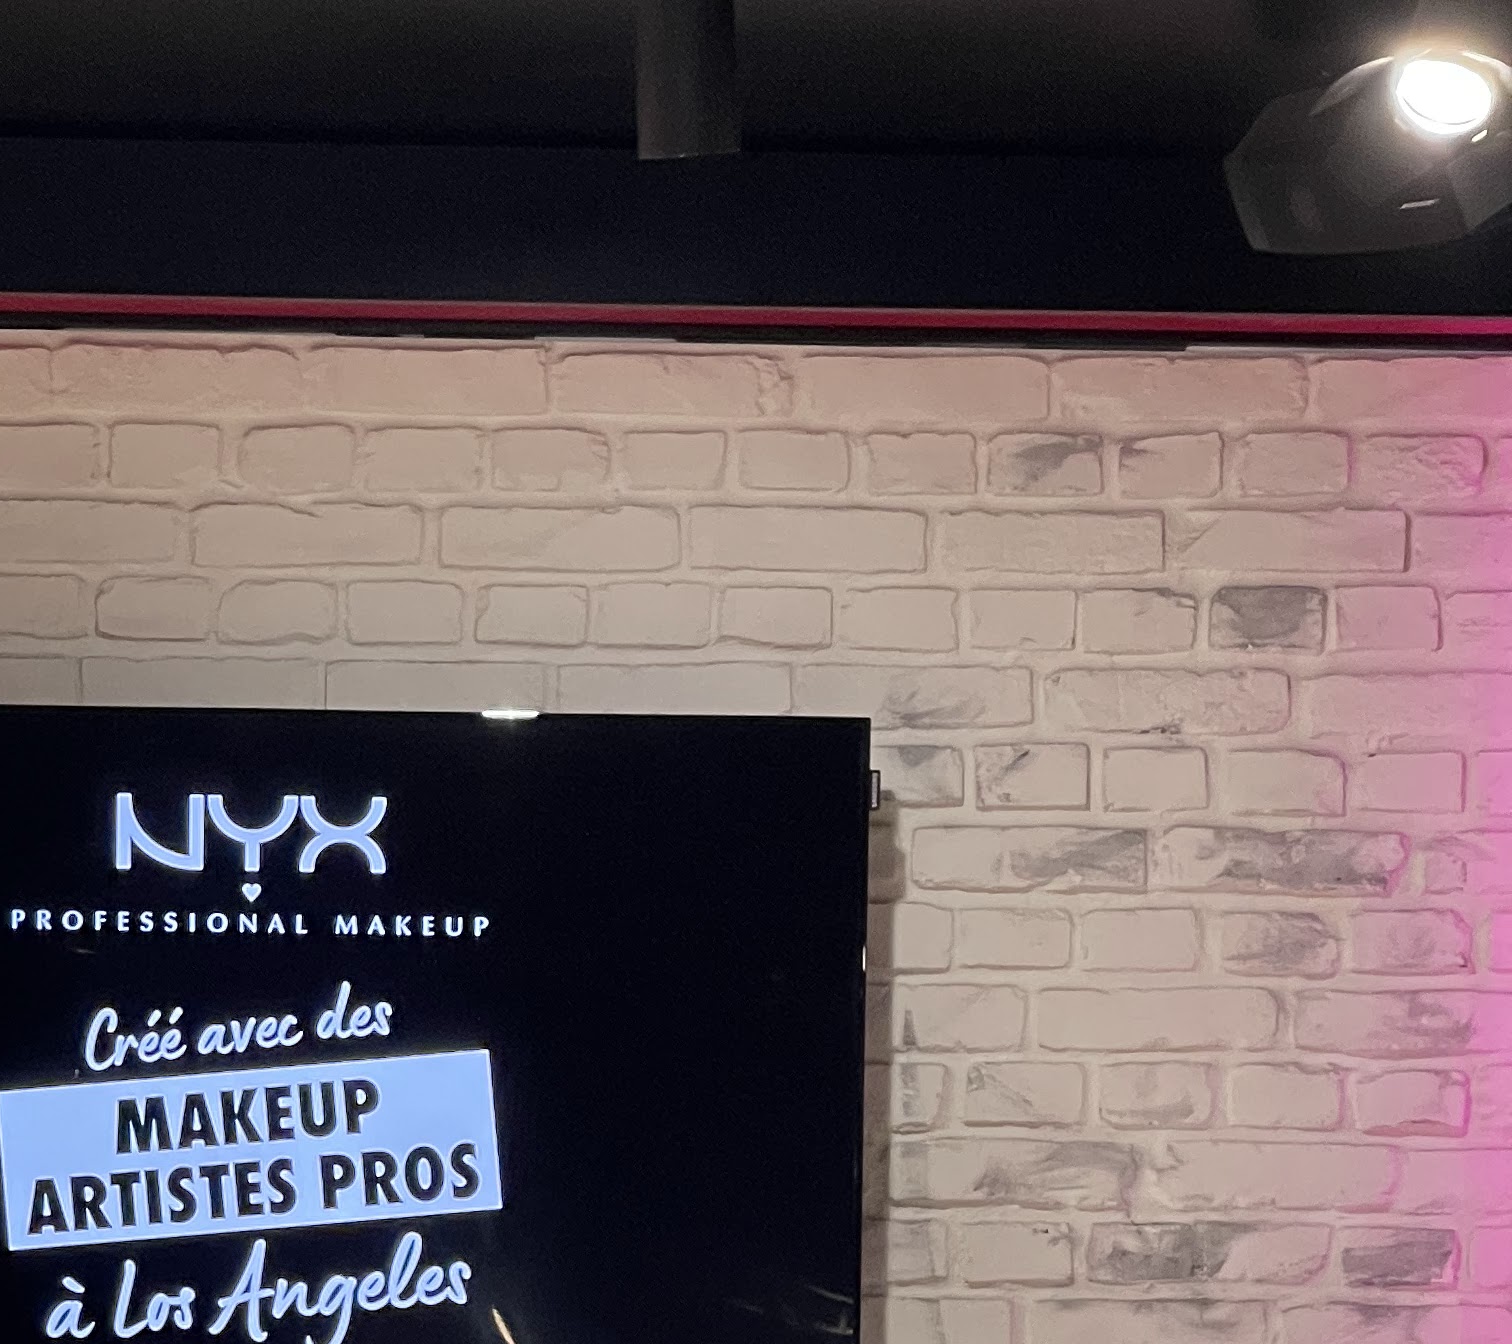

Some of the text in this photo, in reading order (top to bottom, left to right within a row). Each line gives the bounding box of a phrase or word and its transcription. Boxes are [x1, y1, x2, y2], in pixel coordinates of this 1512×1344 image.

[114, 790, 388, 876] NYX
[9, 908, 492, 938] PROFESSIONAL MAKEUP
[85, 980, 393, 1072] Créé avec des
[116, 1079, 381, 1155] MAKEUP
[26, 1143, 480, 1236] ARTISTES PROS
[45, 1276, 96, 1339] à
[113, 1258, 196, 1340] Los
